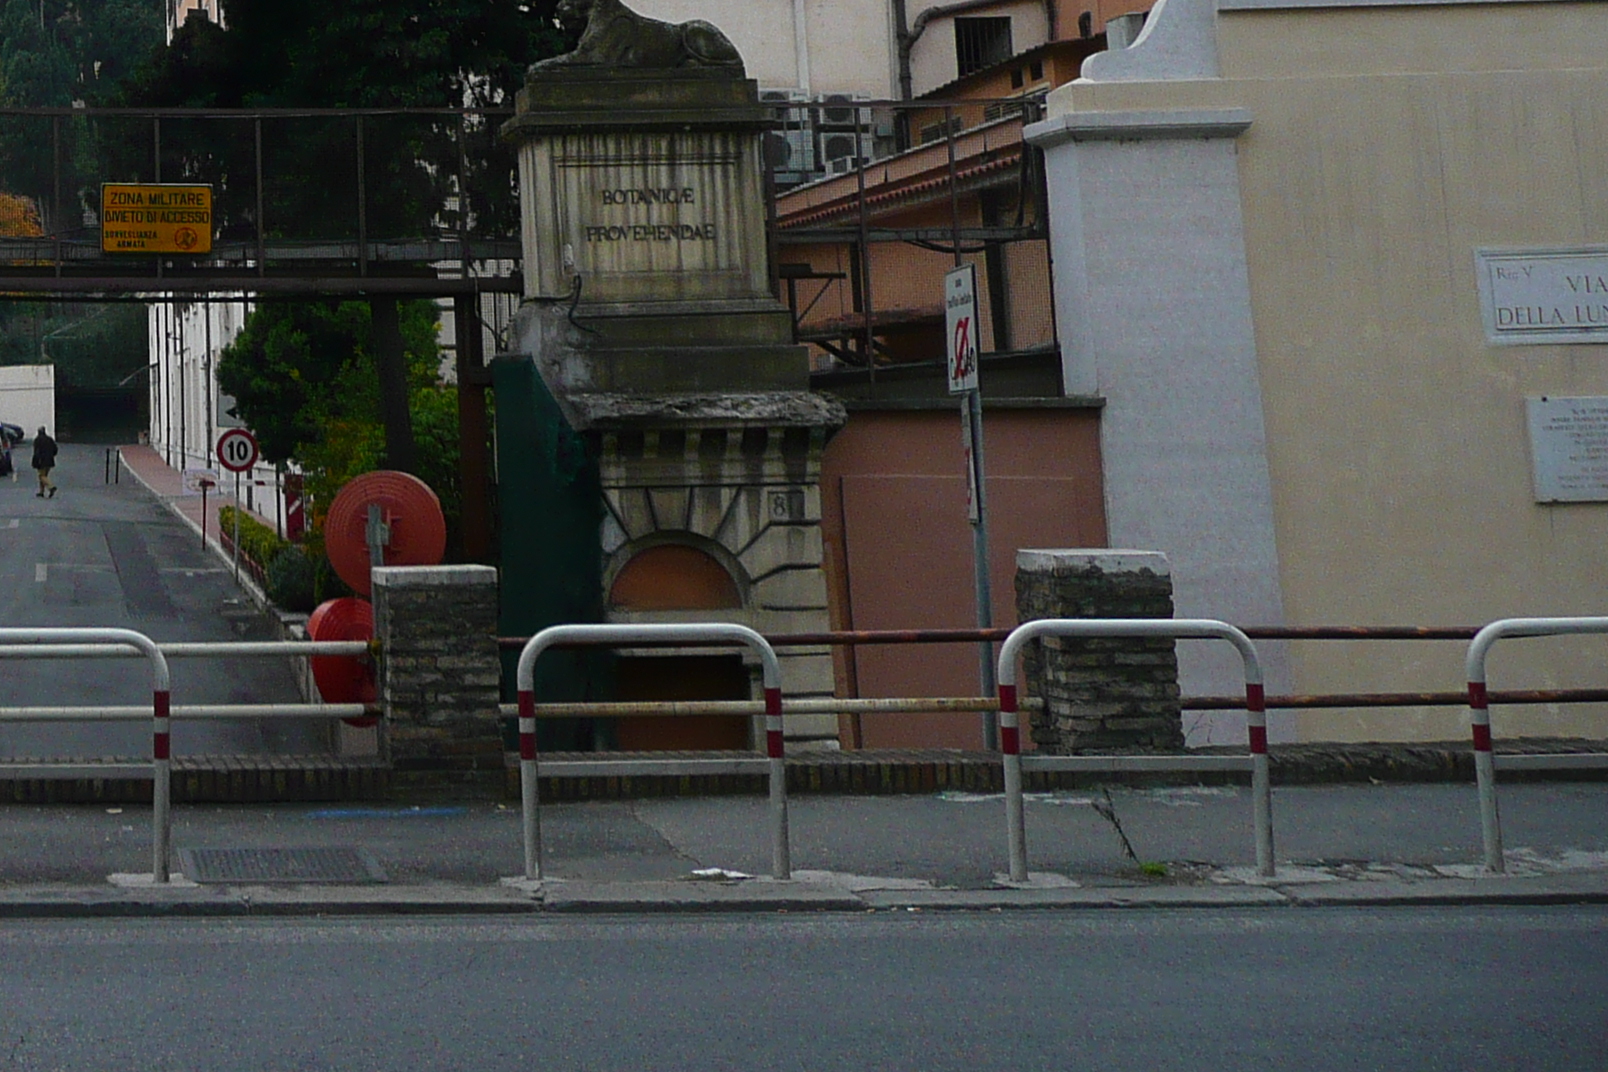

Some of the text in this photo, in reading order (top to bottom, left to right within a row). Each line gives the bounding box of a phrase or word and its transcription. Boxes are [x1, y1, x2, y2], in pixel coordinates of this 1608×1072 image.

[110, 192, 205, 206] ZONA MILITARE
[105, 210, 209, 224] DIVIETO DI ACCESSO
[585, 223, 717, 242] PROVEHENDAE
[1566, 275, 1608, 293] VIA
[1498, 306, 1565, 325] DELLA
[227, 440, 248, 461] 10
